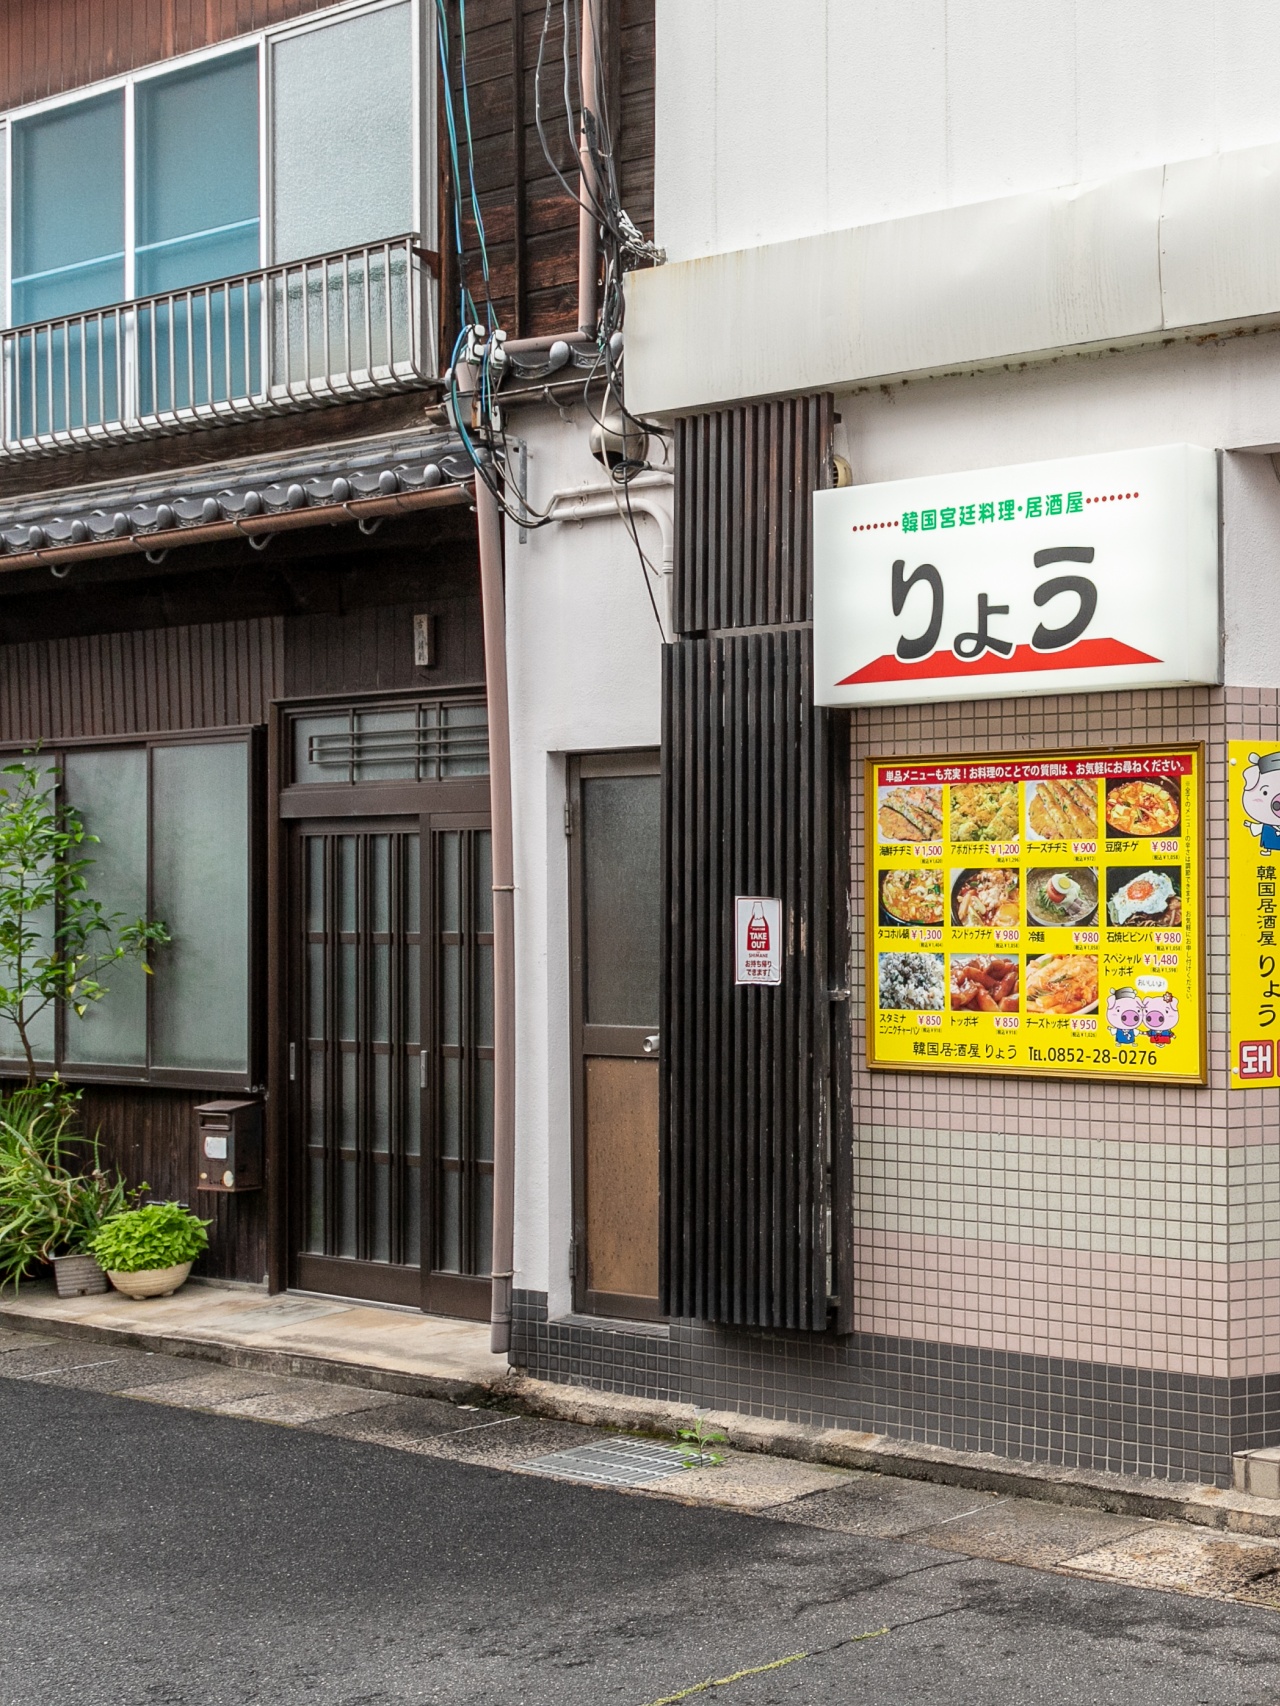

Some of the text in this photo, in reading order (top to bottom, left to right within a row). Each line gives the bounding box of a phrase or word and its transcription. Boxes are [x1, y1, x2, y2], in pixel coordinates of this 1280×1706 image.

[901, 491, 1085, 534] 韓国宮廷料理・居酒屋
[891, 546, 1099, 660] りょう
[914, 845, 943, 857] ¥1,500
[990, 844, 1020, 856] ¥1,200
[1026, 842, 1097, 853] チーズチヂミ ¥900
[1105, 840, 1179, 853] 豆腐チゲ ¥980
[1256, 865, 1278, 947] 韓国居酒屋
[749, 932, 767, 940] TAKE
[911, 929, 942, 941] ¥1,300
[951, 929, 1020, 940] スンドゥブチゲ ¥980
[1028, 931, 1099, 943] 冷麺 ¥980
[1106, 931, 1181, 943] 石焼ビビンバ ¥980
[751, 940, 766, 949] OUT
[1103, 953, 1178, 967] スペシャル ¥1,480
[1104, 966, 1134, 977] トッポギ
[879, 1013, 942, 1026] スタミナ ¥850
[950, 1016, 1019, 1028] トッポギ ¥850
[1026, 1018, 1097, 1030] チーズトッポギ ¥950
[912, 1041, 981, 1058] 韓国居酒屋
[985, 1043, 1017, 1059] りょう
